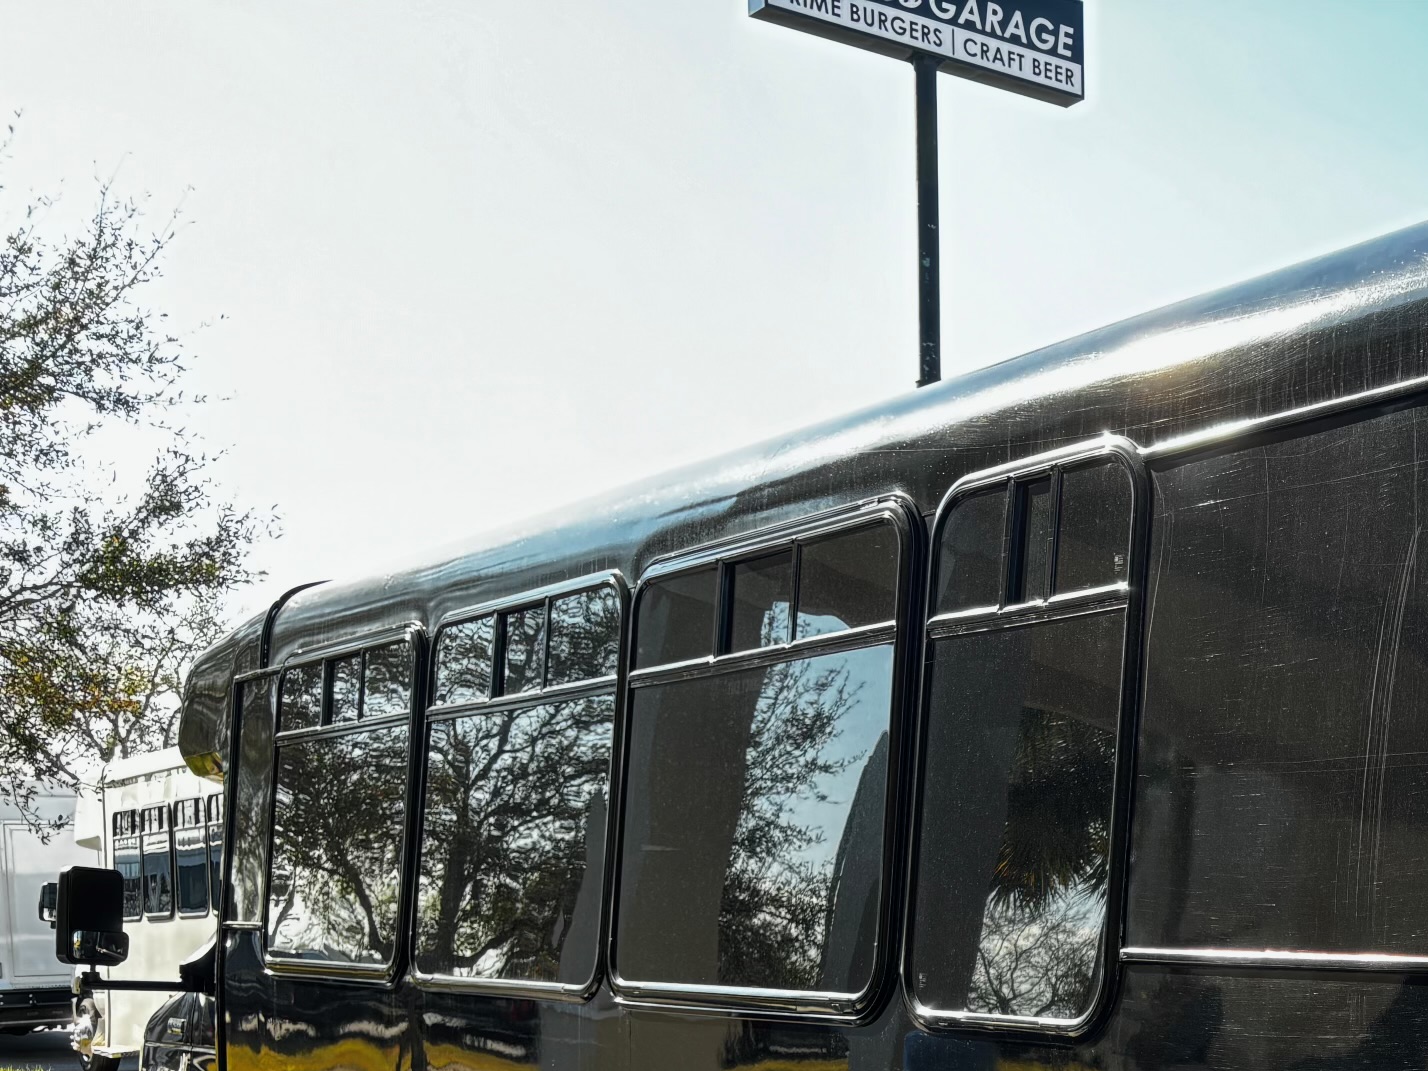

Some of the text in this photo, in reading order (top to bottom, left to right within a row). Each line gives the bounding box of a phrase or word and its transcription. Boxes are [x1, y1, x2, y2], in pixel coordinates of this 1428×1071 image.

[850, 3, 943, 48] BURGERS
[963, 38, 1025, 72] CRAFT
[1032, 58, 1075, 87] BEER
[929, 0, 1074, 57] GARAGE
